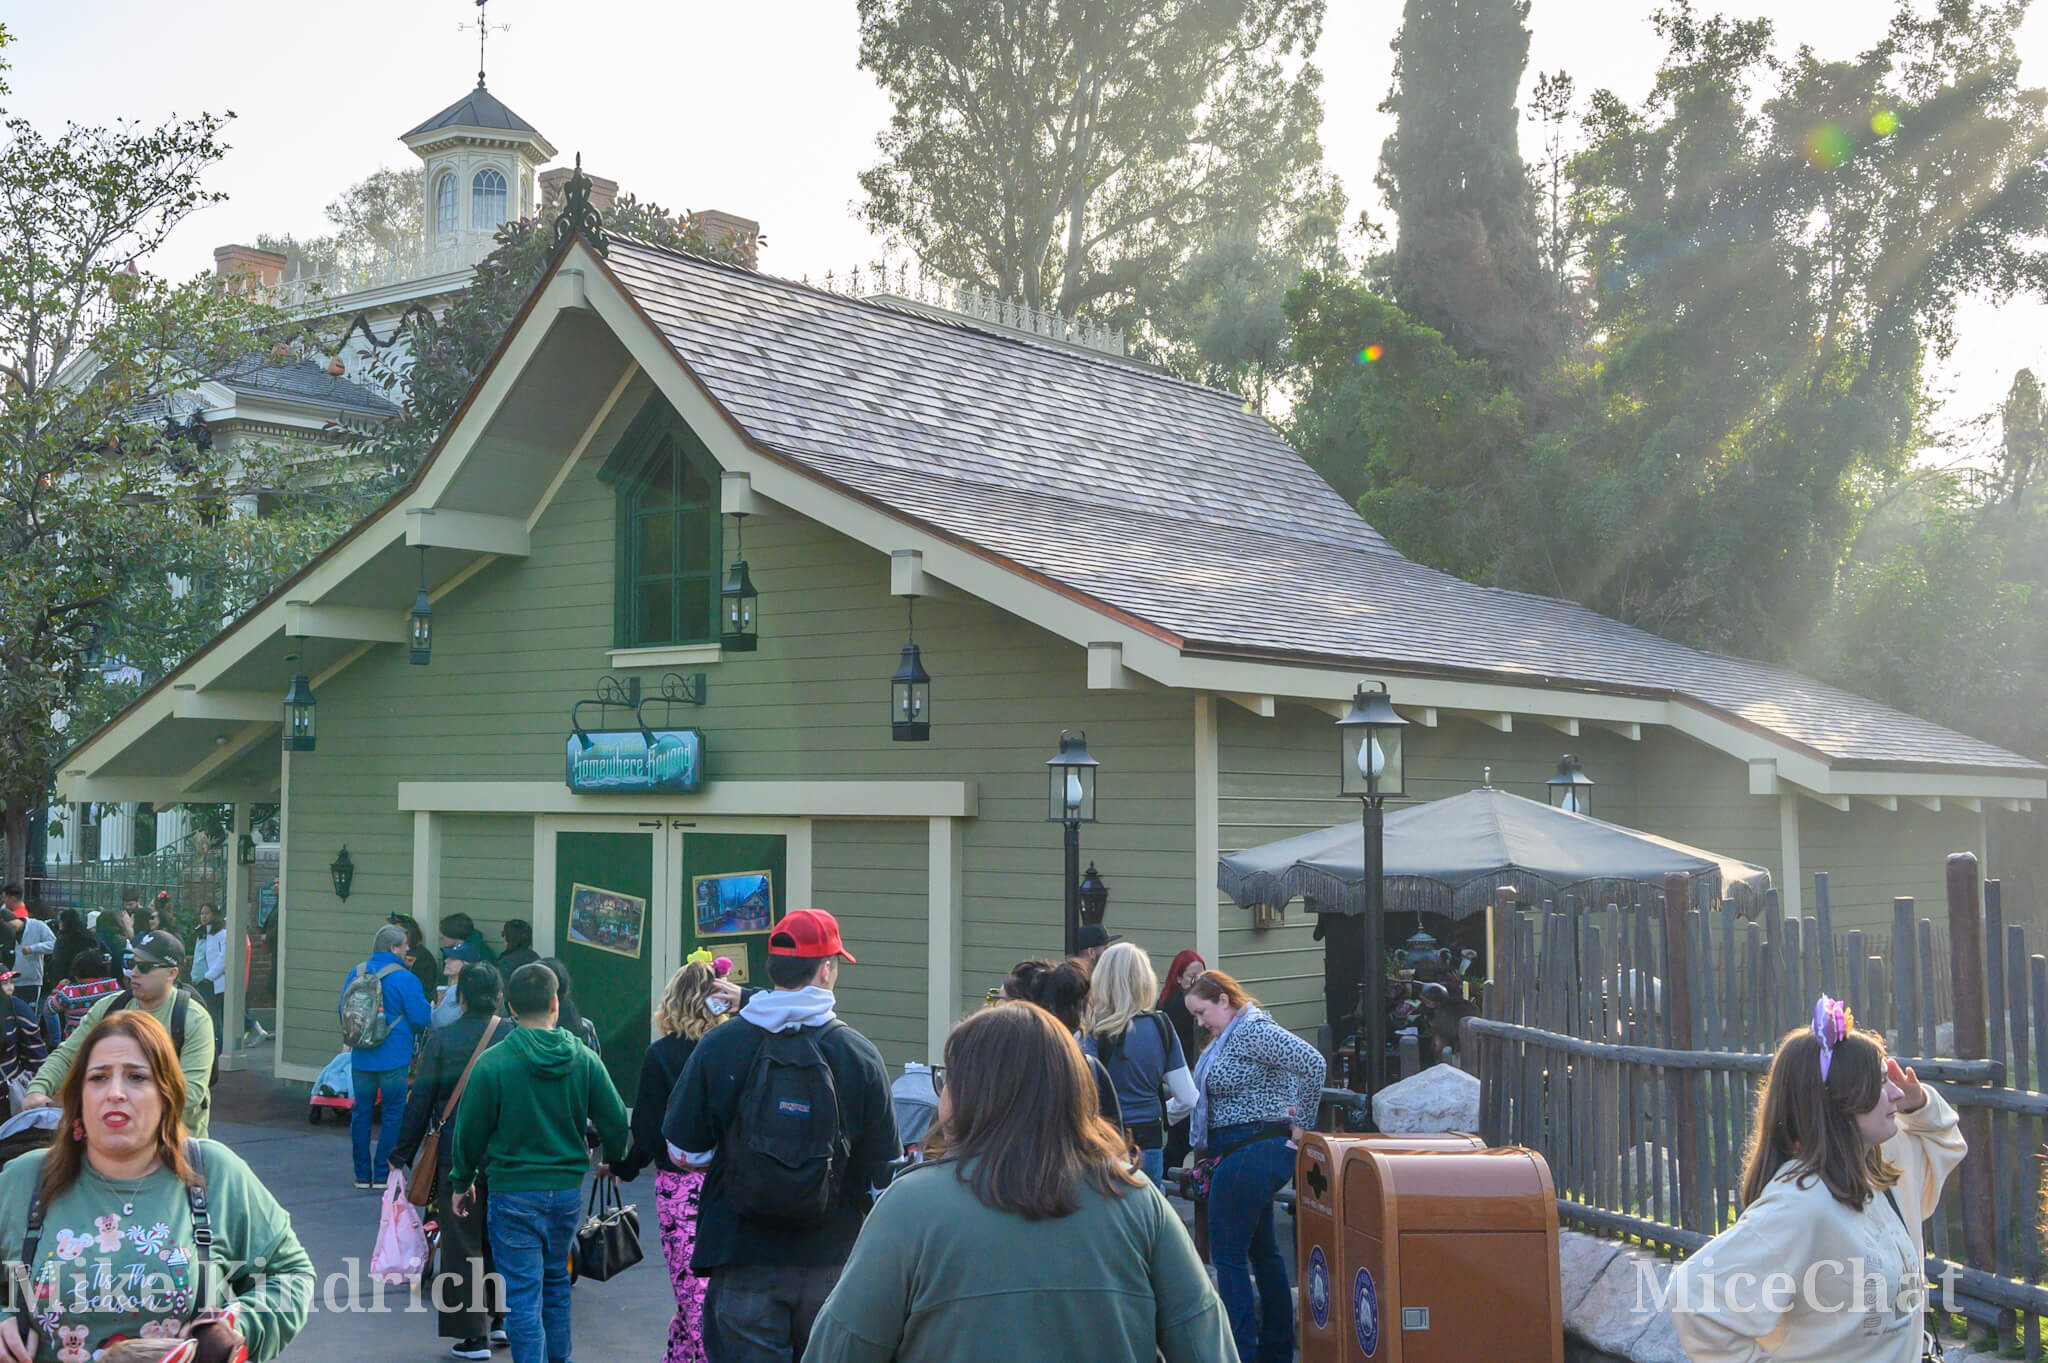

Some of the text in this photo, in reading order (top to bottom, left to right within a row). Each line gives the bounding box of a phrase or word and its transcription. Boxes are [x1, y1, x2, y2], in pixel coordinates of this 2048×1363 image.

[573, 745, 644, 786] Somewhere
[123, 1203, 133, 1215] C
[124, 1263, 158, 1291] The
[67, 1279, 161, 1314] Season
